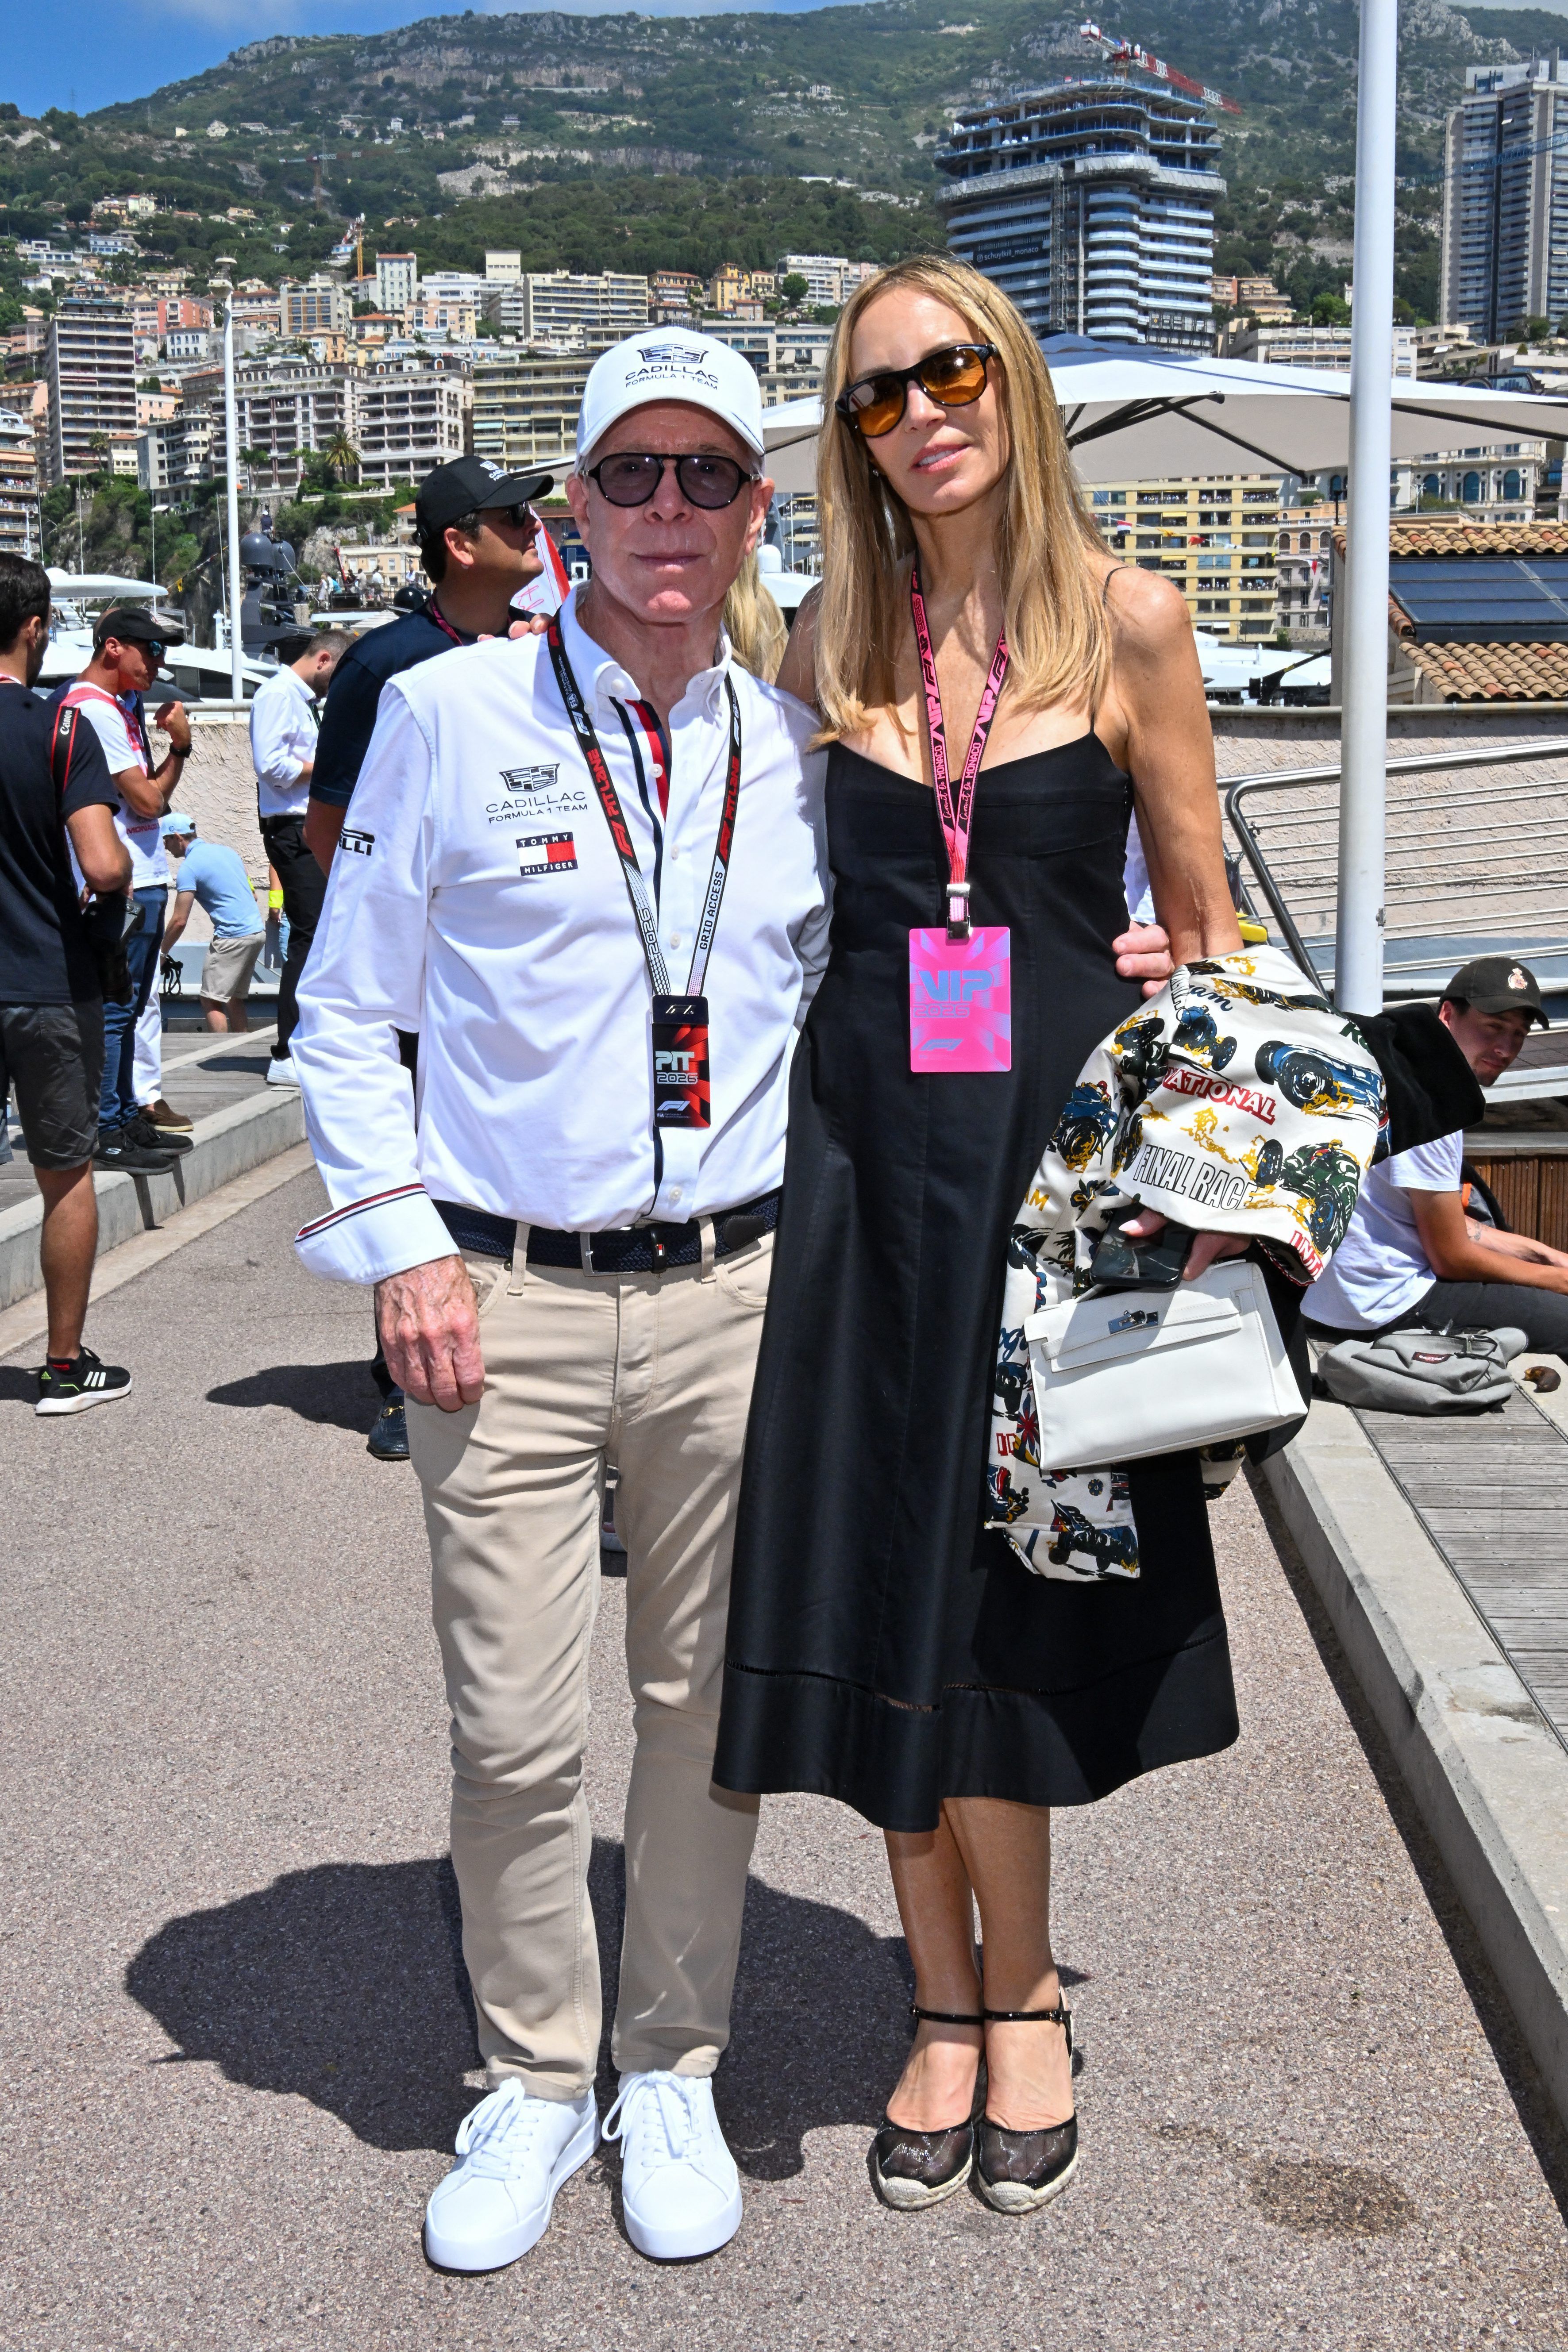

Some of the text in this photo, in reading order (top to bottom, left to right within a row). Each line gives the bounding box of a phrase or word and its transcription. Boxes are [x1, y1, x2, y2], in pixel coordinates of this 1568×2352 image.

[984, 246, 1039, 260] schuylkill_monaco
[625, 365, 718, 383] CADILLAC
[626, 374, 676, 388] FORMULA
[690, 376, 717, 390] TEAM
[60, 710, 73, 735] Canon
[934, 745, 946, 781] MONACO
[965, 742, 981, 779] MONACO
[486, 792, 586, 813] CADILLAC
[601, 791, 619, 817] PIT
[489, 809, 544, 824] FORMULA
[556, 804, 588, 812] TEAM
[520, 834, 568, 847] TOMMY
[524, 862, 574, 874] HILFIGER
[699, 871, 723, 950] GRID ACCESS
[638, 908, 660, 956] 2026
[917, 970, 994, 1002] VIP
[914, 1004, 970, 1017] 2026
[920, 1039, 963, 1051] F1
[655, 1051, 695, 1071] PIT
[658, 1073, 698, 1083] 2026
[657, 1100, 690, 1111] F1
[1133, 1144, 1258, 1210] FINAL RACE
